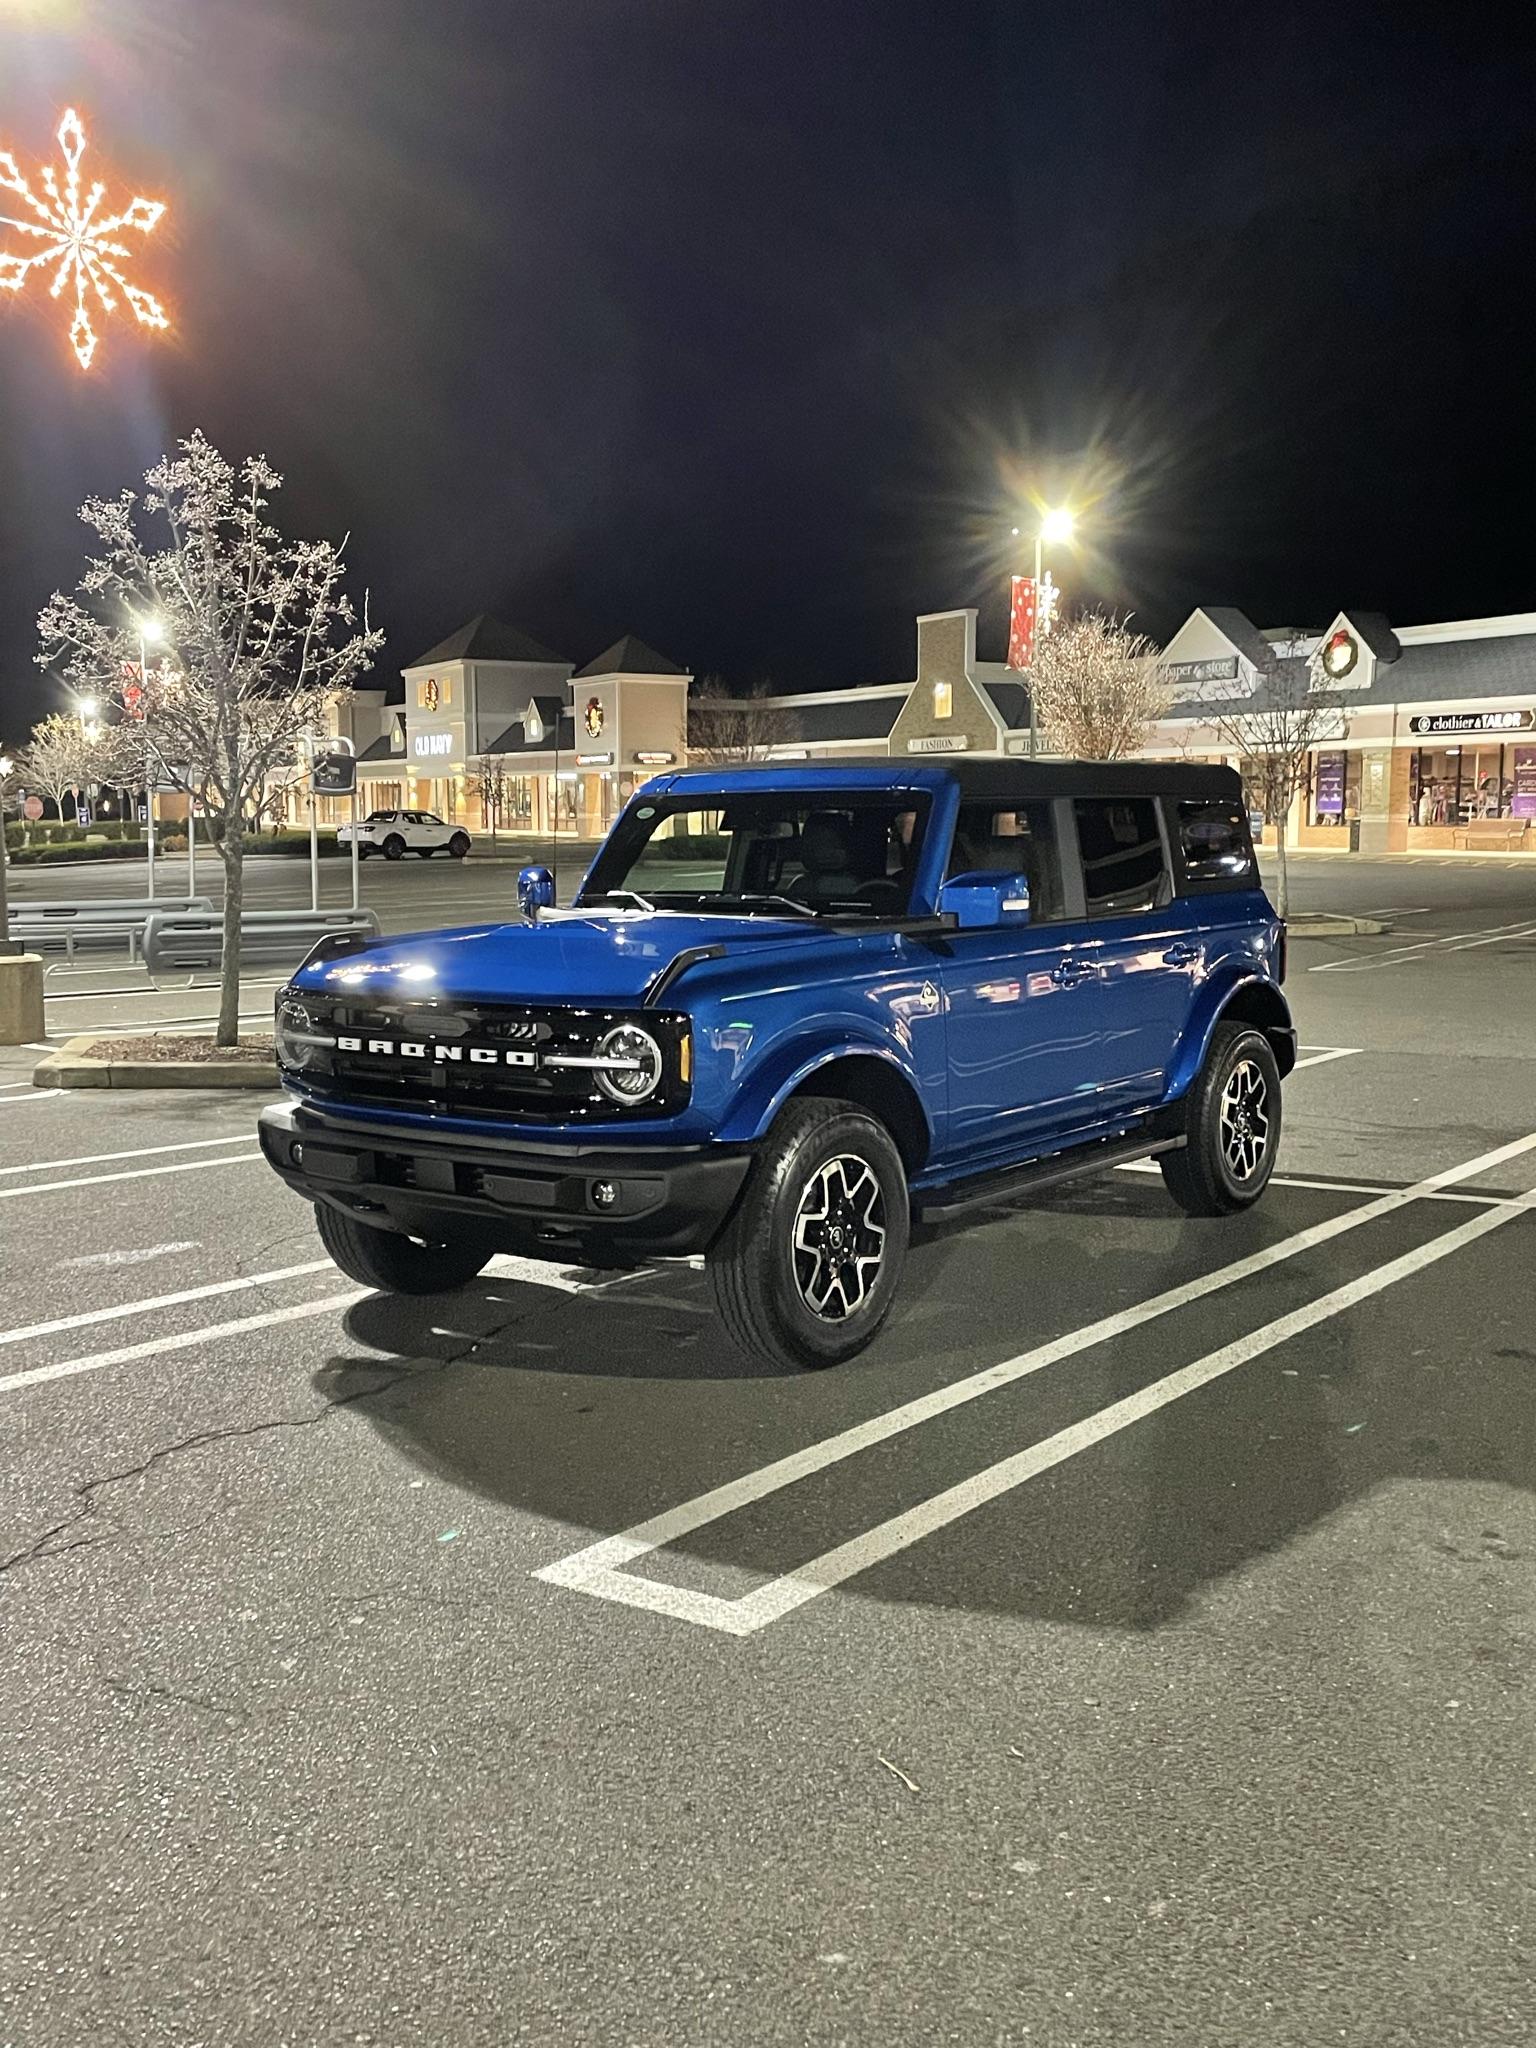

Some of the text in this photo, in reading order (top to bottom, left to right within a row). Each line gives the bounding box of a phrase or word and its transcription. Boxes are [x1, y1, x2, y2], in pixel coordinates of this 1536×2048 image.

[1206, 661, 1232, 674] store
[1433, 716, 1475, 730] clothier
[1482, 712, 1522, 729] TAILOR
[415, 735, 430, 756] OLD
[920, 739, 953, 750] FASHION
[337, 1036, 535, 1063] BRONCO
